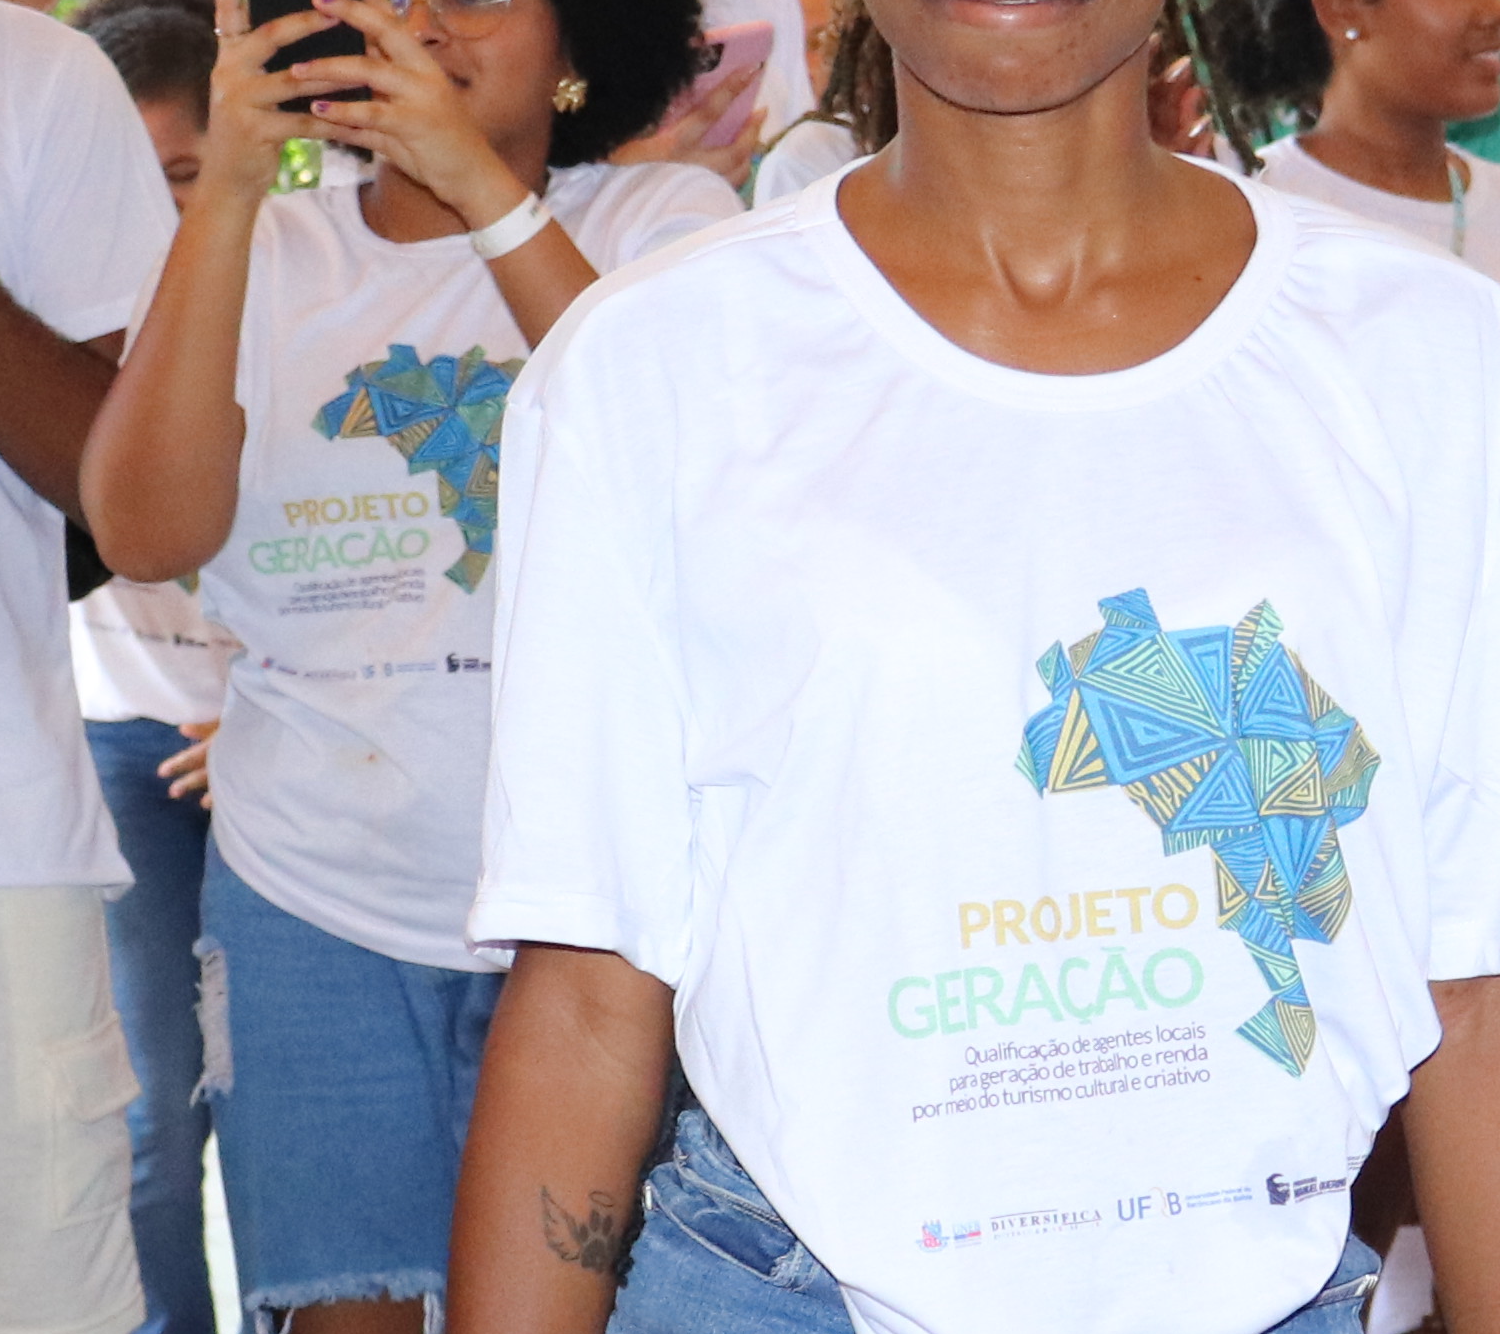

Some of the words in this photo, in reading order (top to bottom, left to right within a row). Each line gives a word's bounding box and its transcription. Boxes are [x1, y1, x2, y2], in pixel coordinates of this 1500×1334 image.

[283, 492, 429, 527] PROJETO
[958, 883, 1199, 949] PROJETO
[887, 946, 1204, 1040] GERAÇÃO
[949, 1073, 978, 1096] para
[980, 1063, 1050, 1091] geração
[1053, 1060, 1076, 1080] de
[1078, 1049, 1139, 1076] trabalho
[1141, 1052, 1152, 1065] e
[1155, 1043, 1209, 1066] renda
[965, 1040, 1070, 1068] Qualificação
[1072, 1035, 1091, 1054] de
[1093, 1028, 1154, 1056] agentes
[1156, 1021, 1206, 1043] locais
[912, 1103, 942, 1123] por
[945, 1094, 977, 1115] meio
[978, 1087, 1000, 1110] do
[1002, 1084, 1073, 1107] turismo
[1075, 1075, 1129, 1099] cultural
[1131, 1078, 1142, 1091] e
[1143, 1065, 1211, 1089] criativo
[991, 1209, 1103, 1233] DIVERSIFICA
